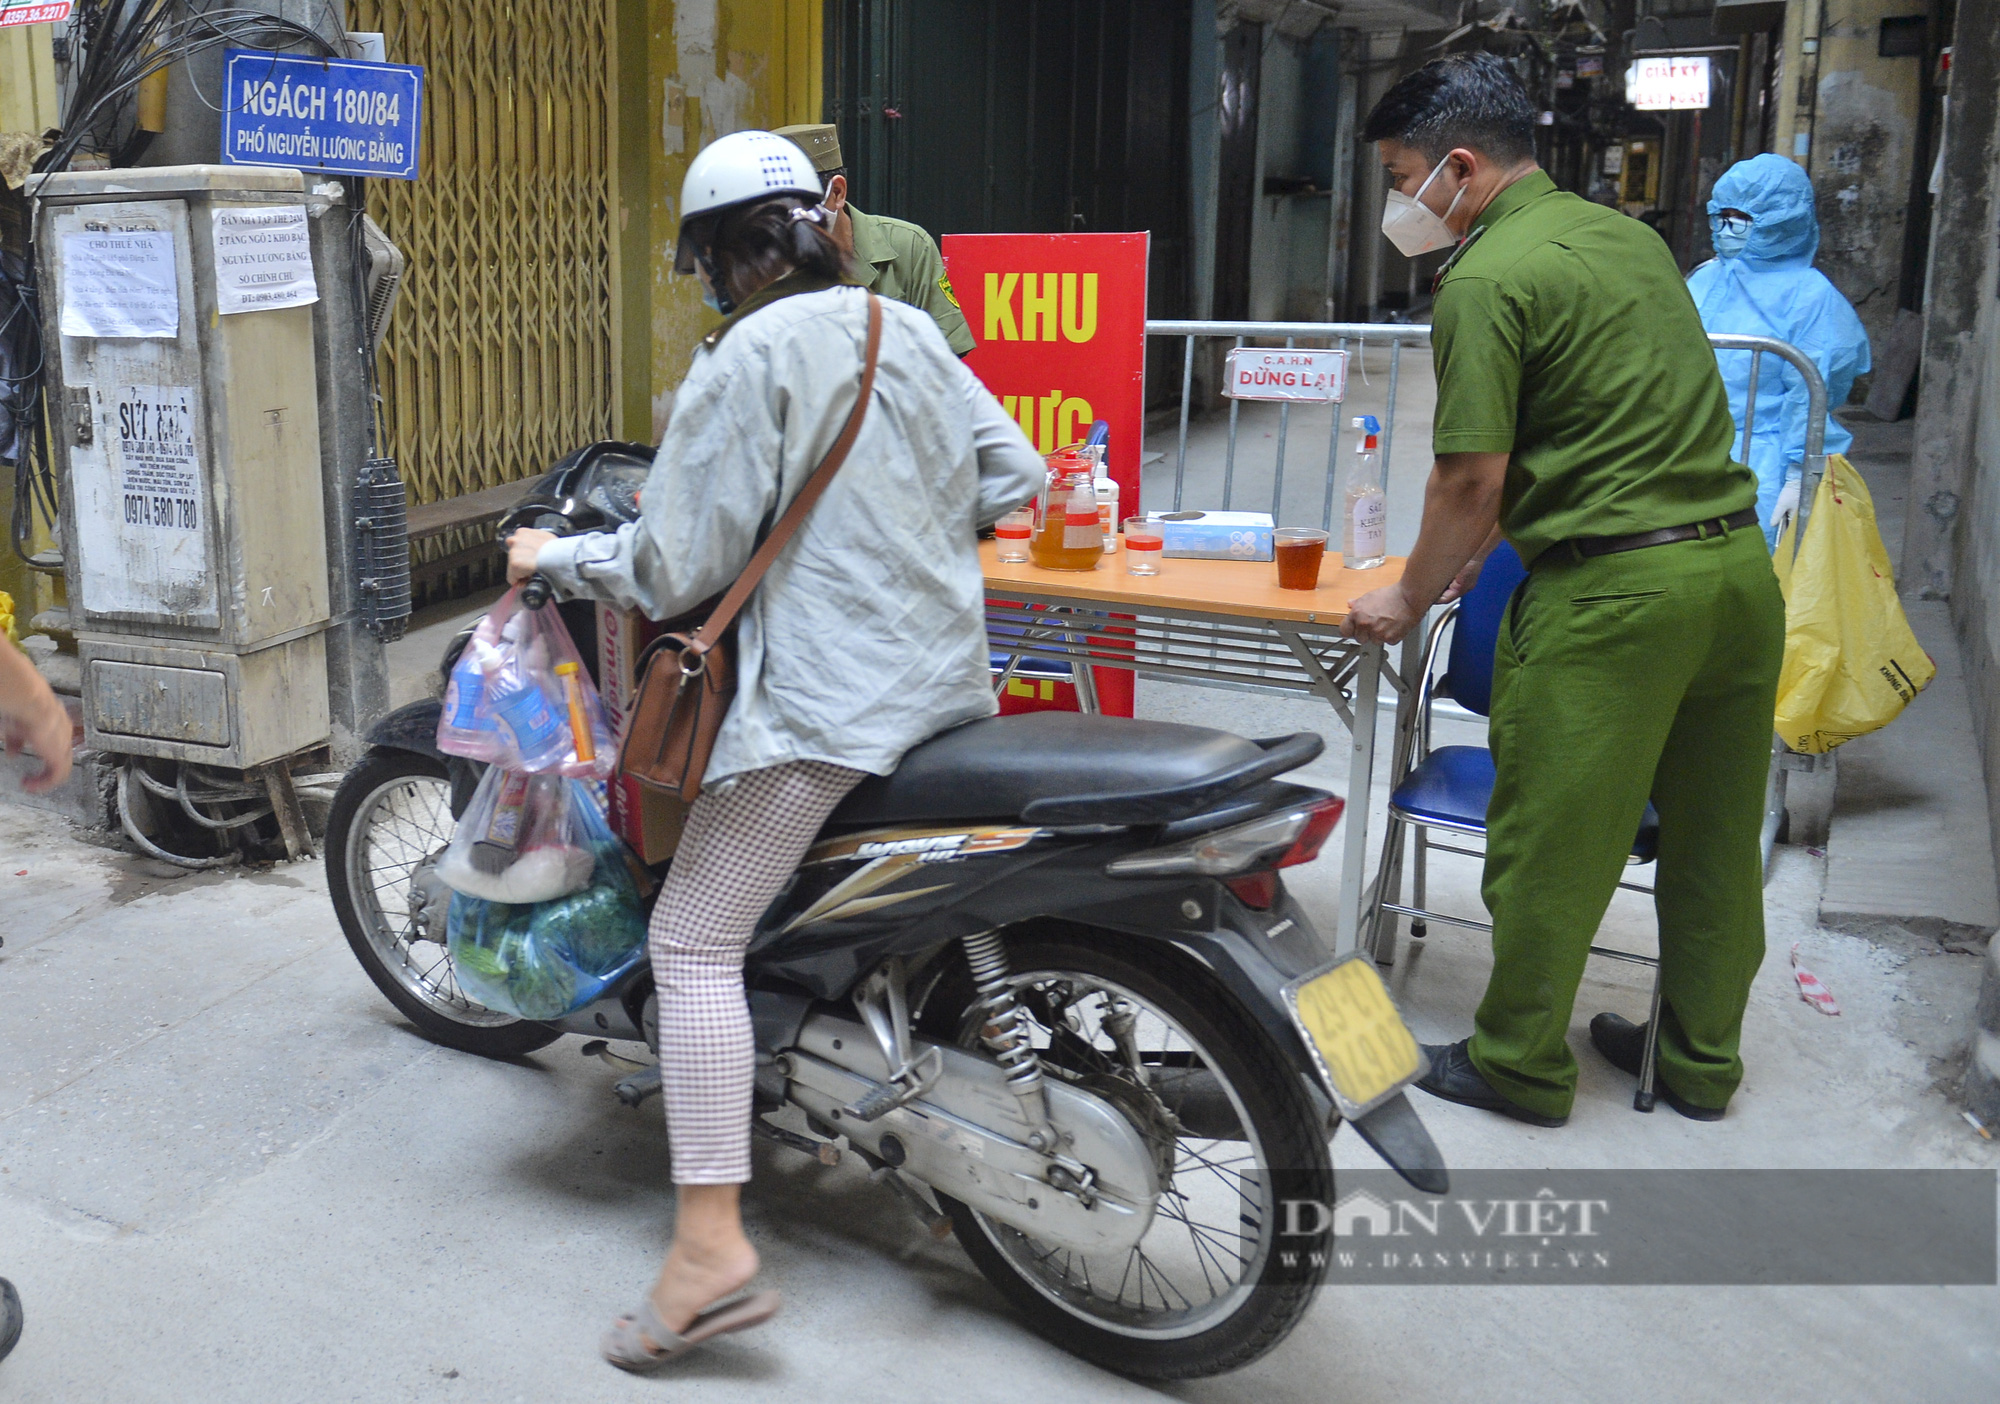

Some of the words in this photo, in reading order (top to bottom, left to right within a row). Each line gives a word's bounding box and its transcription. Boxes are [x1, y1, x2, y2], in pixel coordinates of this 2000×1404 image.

[242, 75, 326, 121] NGÁCH
[333, 88, 400, 127] 180/84
[236, 124, 265, 153] PHỐ
[267, 126, 320, 157] NGUYỄN
[322, 136, 366, 160] LƯƠNG
[368, 132, 403, 164] BẰNG
[89, 240, 108, 249] CHO
[273, 234, 291, 243] KHO
[984, 273, 1098, 343] KHU
[1263, 356, 1313, 366] C.A.H.N
[1240, 366, 1296, 386] DỪNG
[1301, 373, 1335, 390] LẠI
[124, 494, 151, 525] 0974
[153, 497, 173, 527] 580
[176, 499, 197, 529] 780
